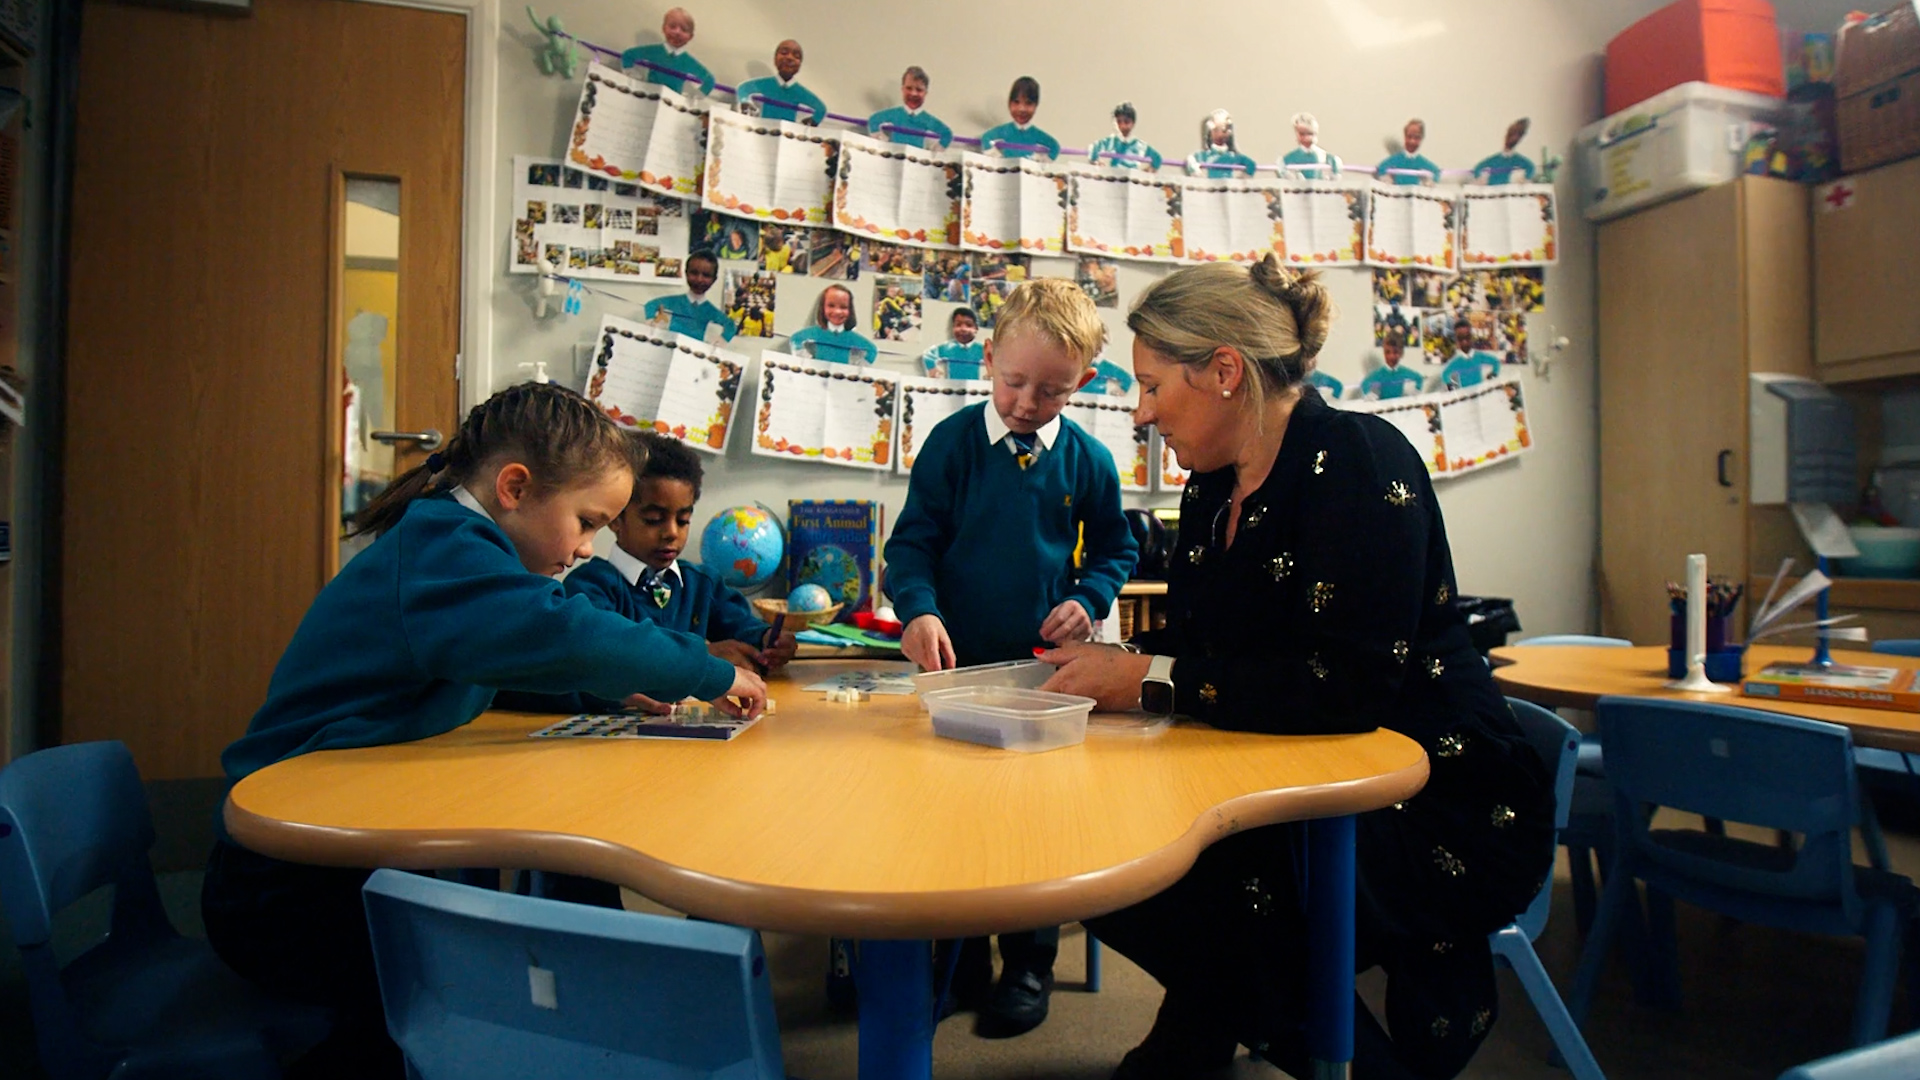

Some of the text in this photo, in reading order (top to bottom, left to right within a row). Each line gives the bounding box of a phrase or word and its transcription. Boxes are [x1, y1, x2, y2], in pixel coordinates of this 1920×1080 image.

[793, 514, 867, 529] First Animal
[1803, 687, 1894, 702] SEASONS GAME
